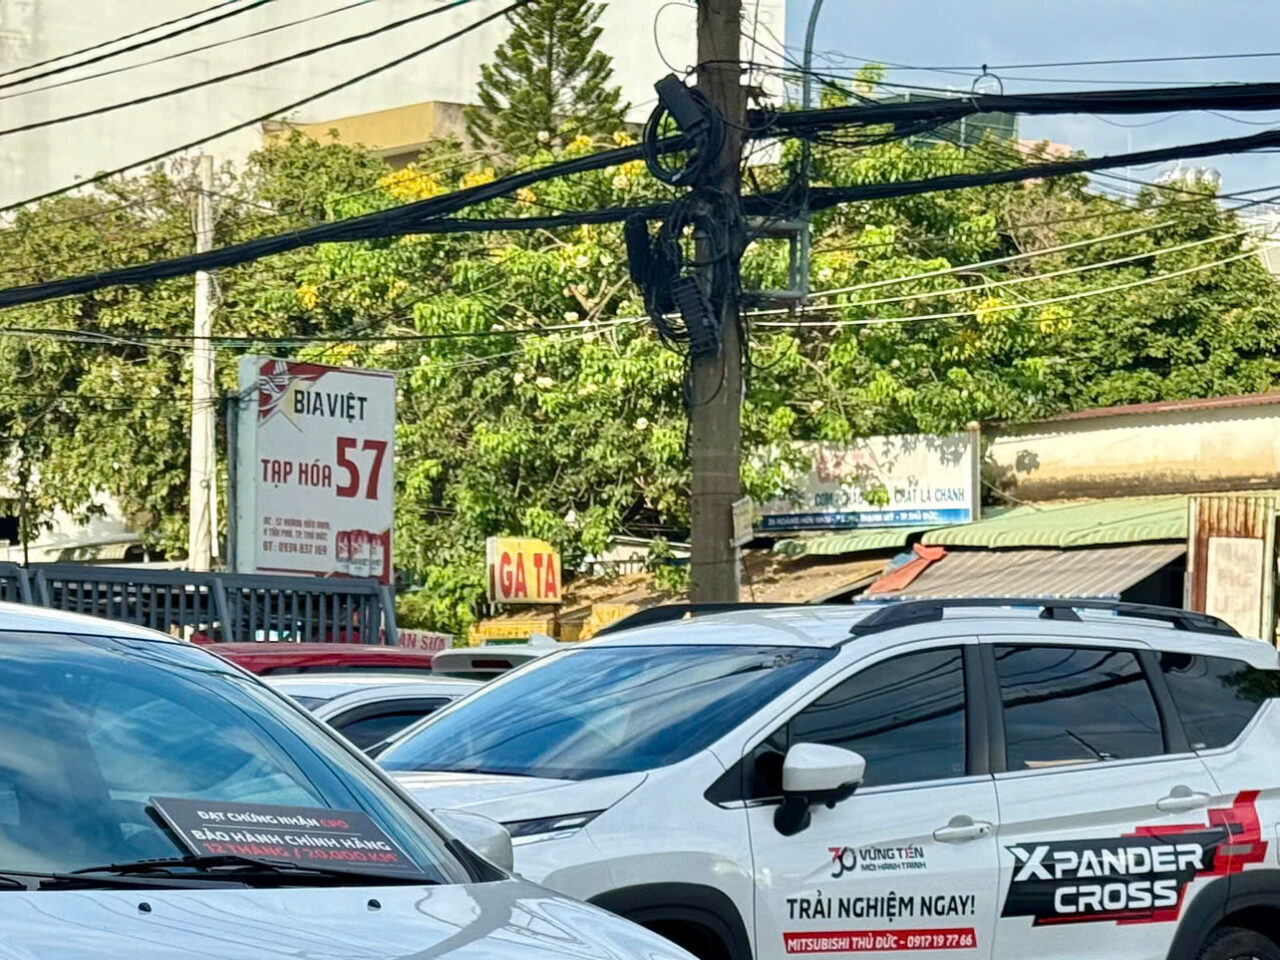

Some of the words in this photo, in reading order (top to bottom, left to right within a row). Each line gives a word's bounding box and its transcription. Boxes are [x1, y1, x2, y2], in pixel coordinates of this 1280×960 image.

[294, 390, 324, 417] BIA
[326, 391, 367, 423] VIỆT
[261, 459, 293, 488] TẠP
[298, 458, 332, 487] HÓA
[336, 437, 387, 500] 57
[1010, 843, 1204, 882] XPANDER
[787, 889, 832, 919] TRẢI
[838, 891, 914, 922] NGHIỆM
[921, 895, 975, 917] NGAY!
[1054, 880, 1177, 913] CROSS
[787, 937, 850, 951] MITSUBISHI
[907, 935, 932, 948] 0917
[933, 935, 945, 947] 19
[946, 934, 958, 946] 77
[960, 934, 972, 946] 66
